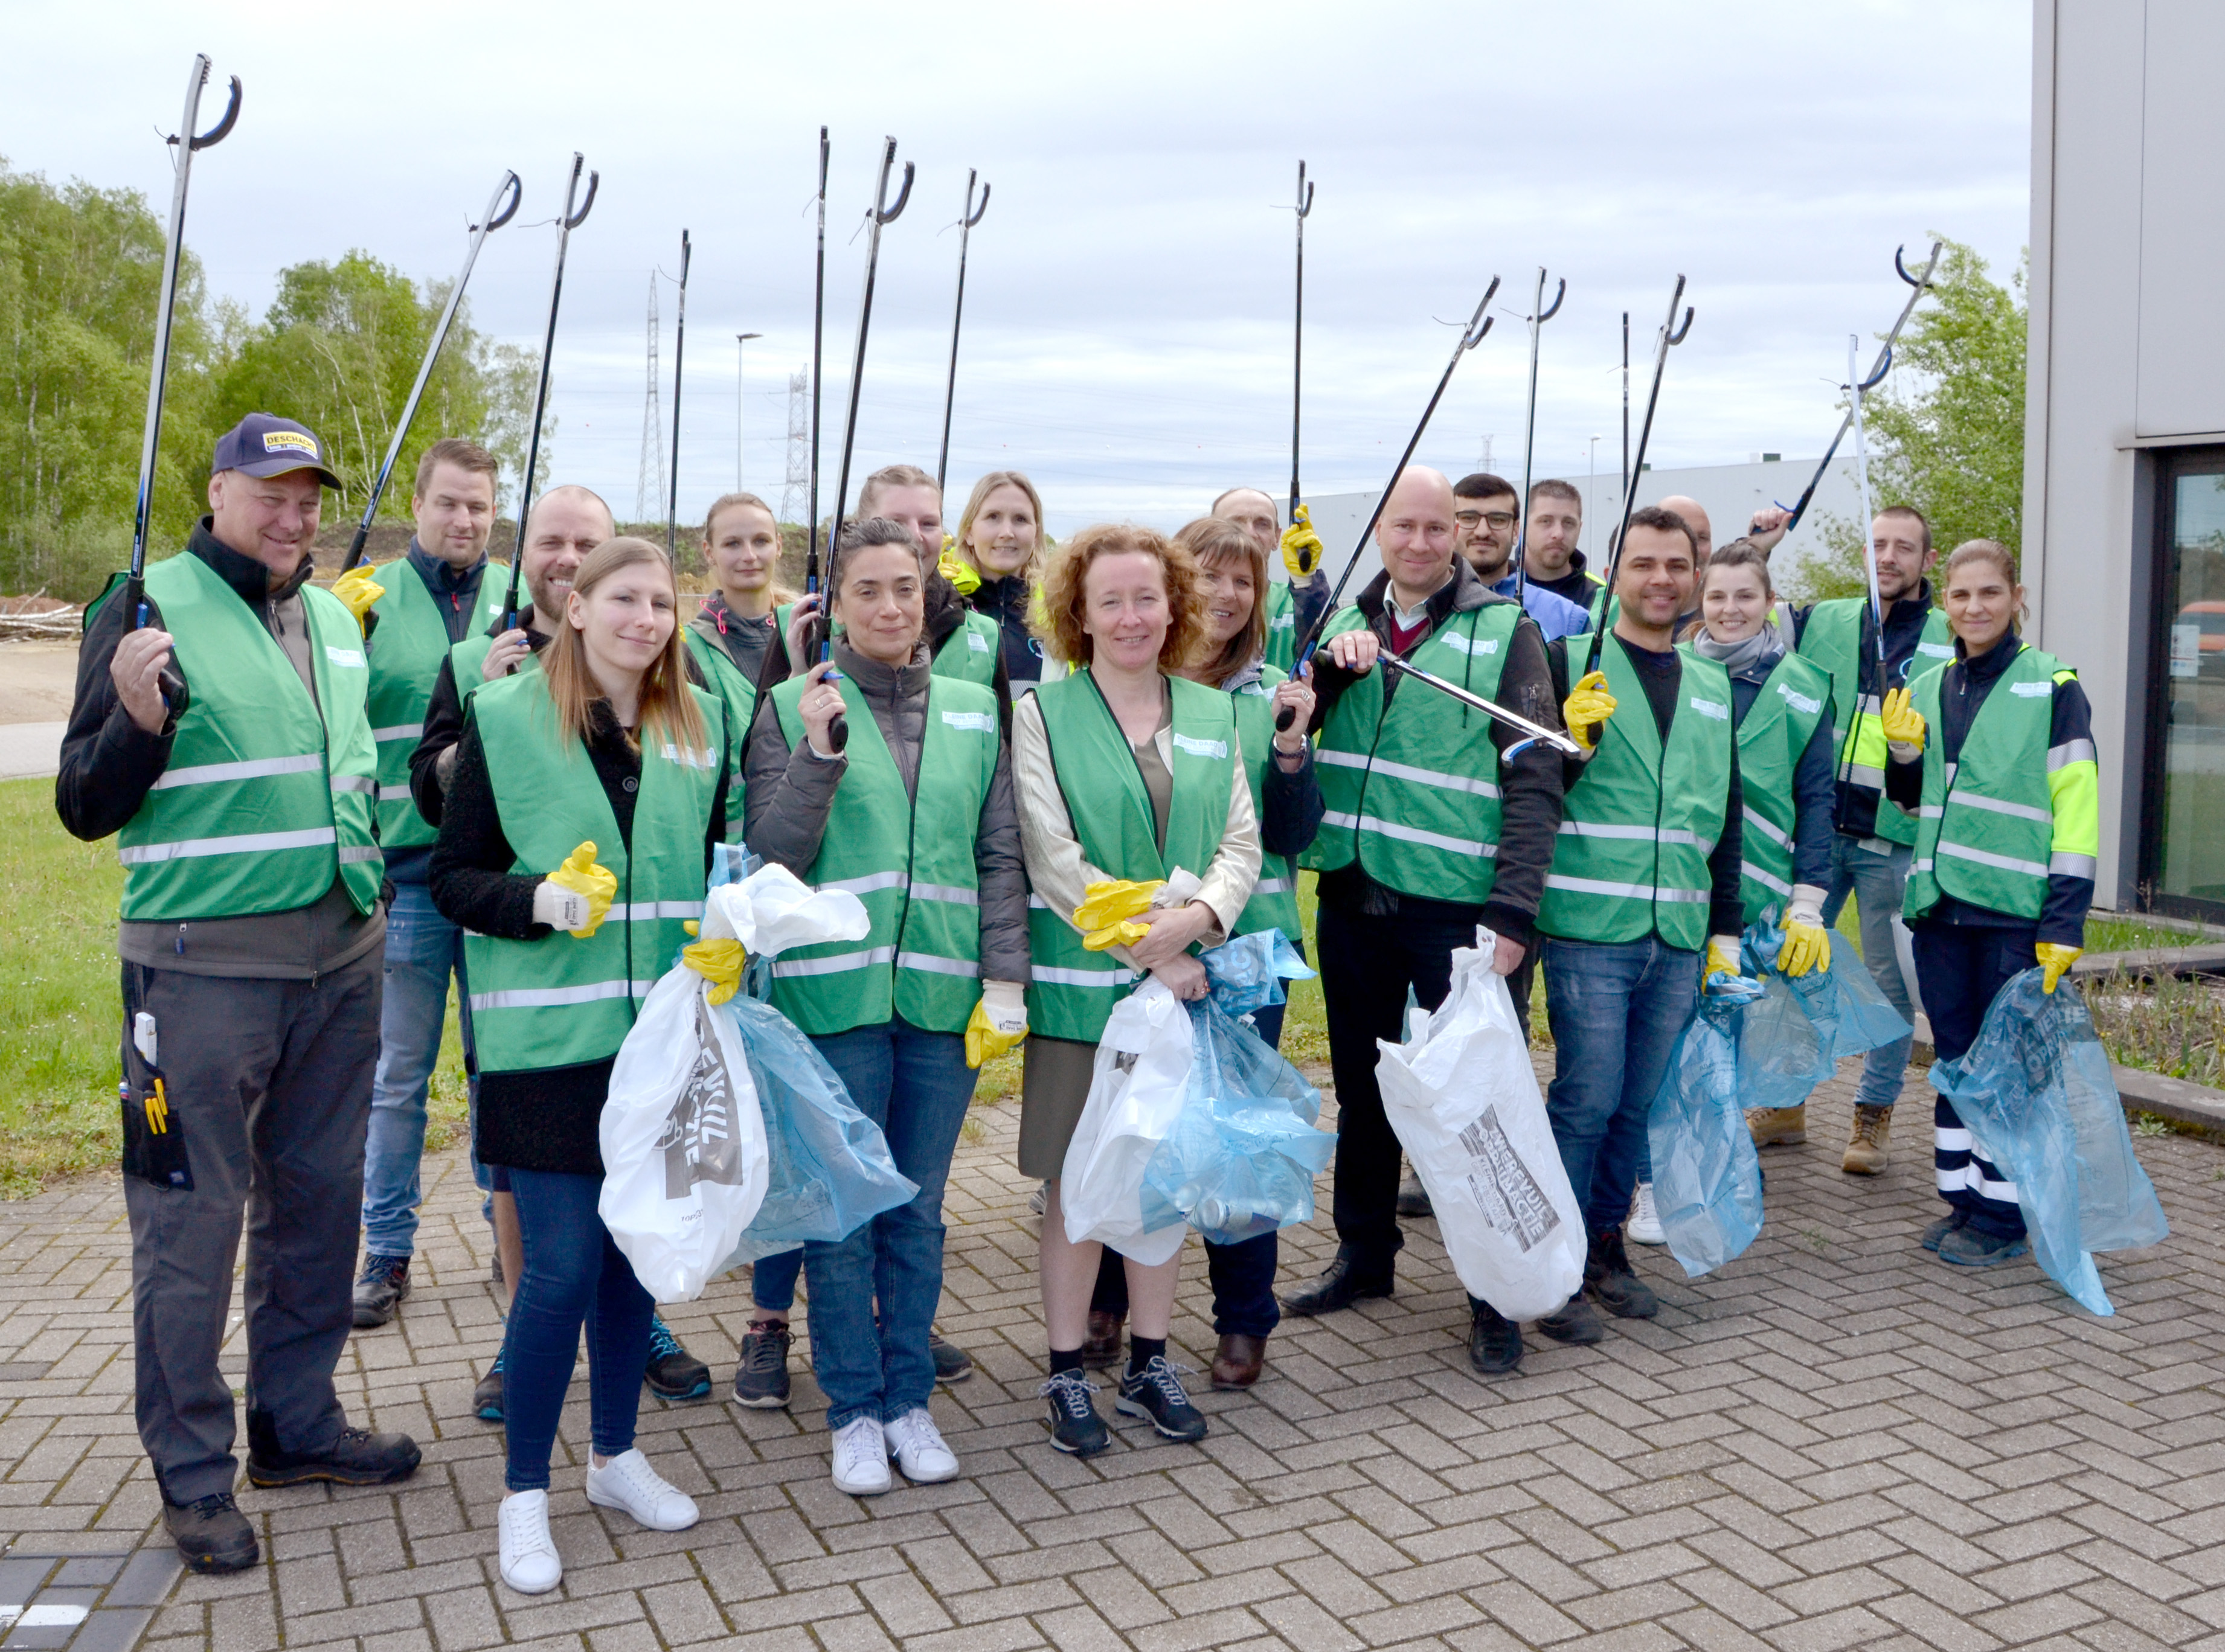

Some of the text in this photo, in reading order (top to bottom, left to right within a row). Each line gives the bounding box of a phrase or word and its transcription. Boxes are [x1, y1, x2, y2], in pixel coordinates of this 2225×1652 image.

[267, 435, 315, 450] DESCHACHT
[1177, 734, 1197, 746] KLEINE
[1489, 1127, 1547, 1219] ZWERFVUIL
